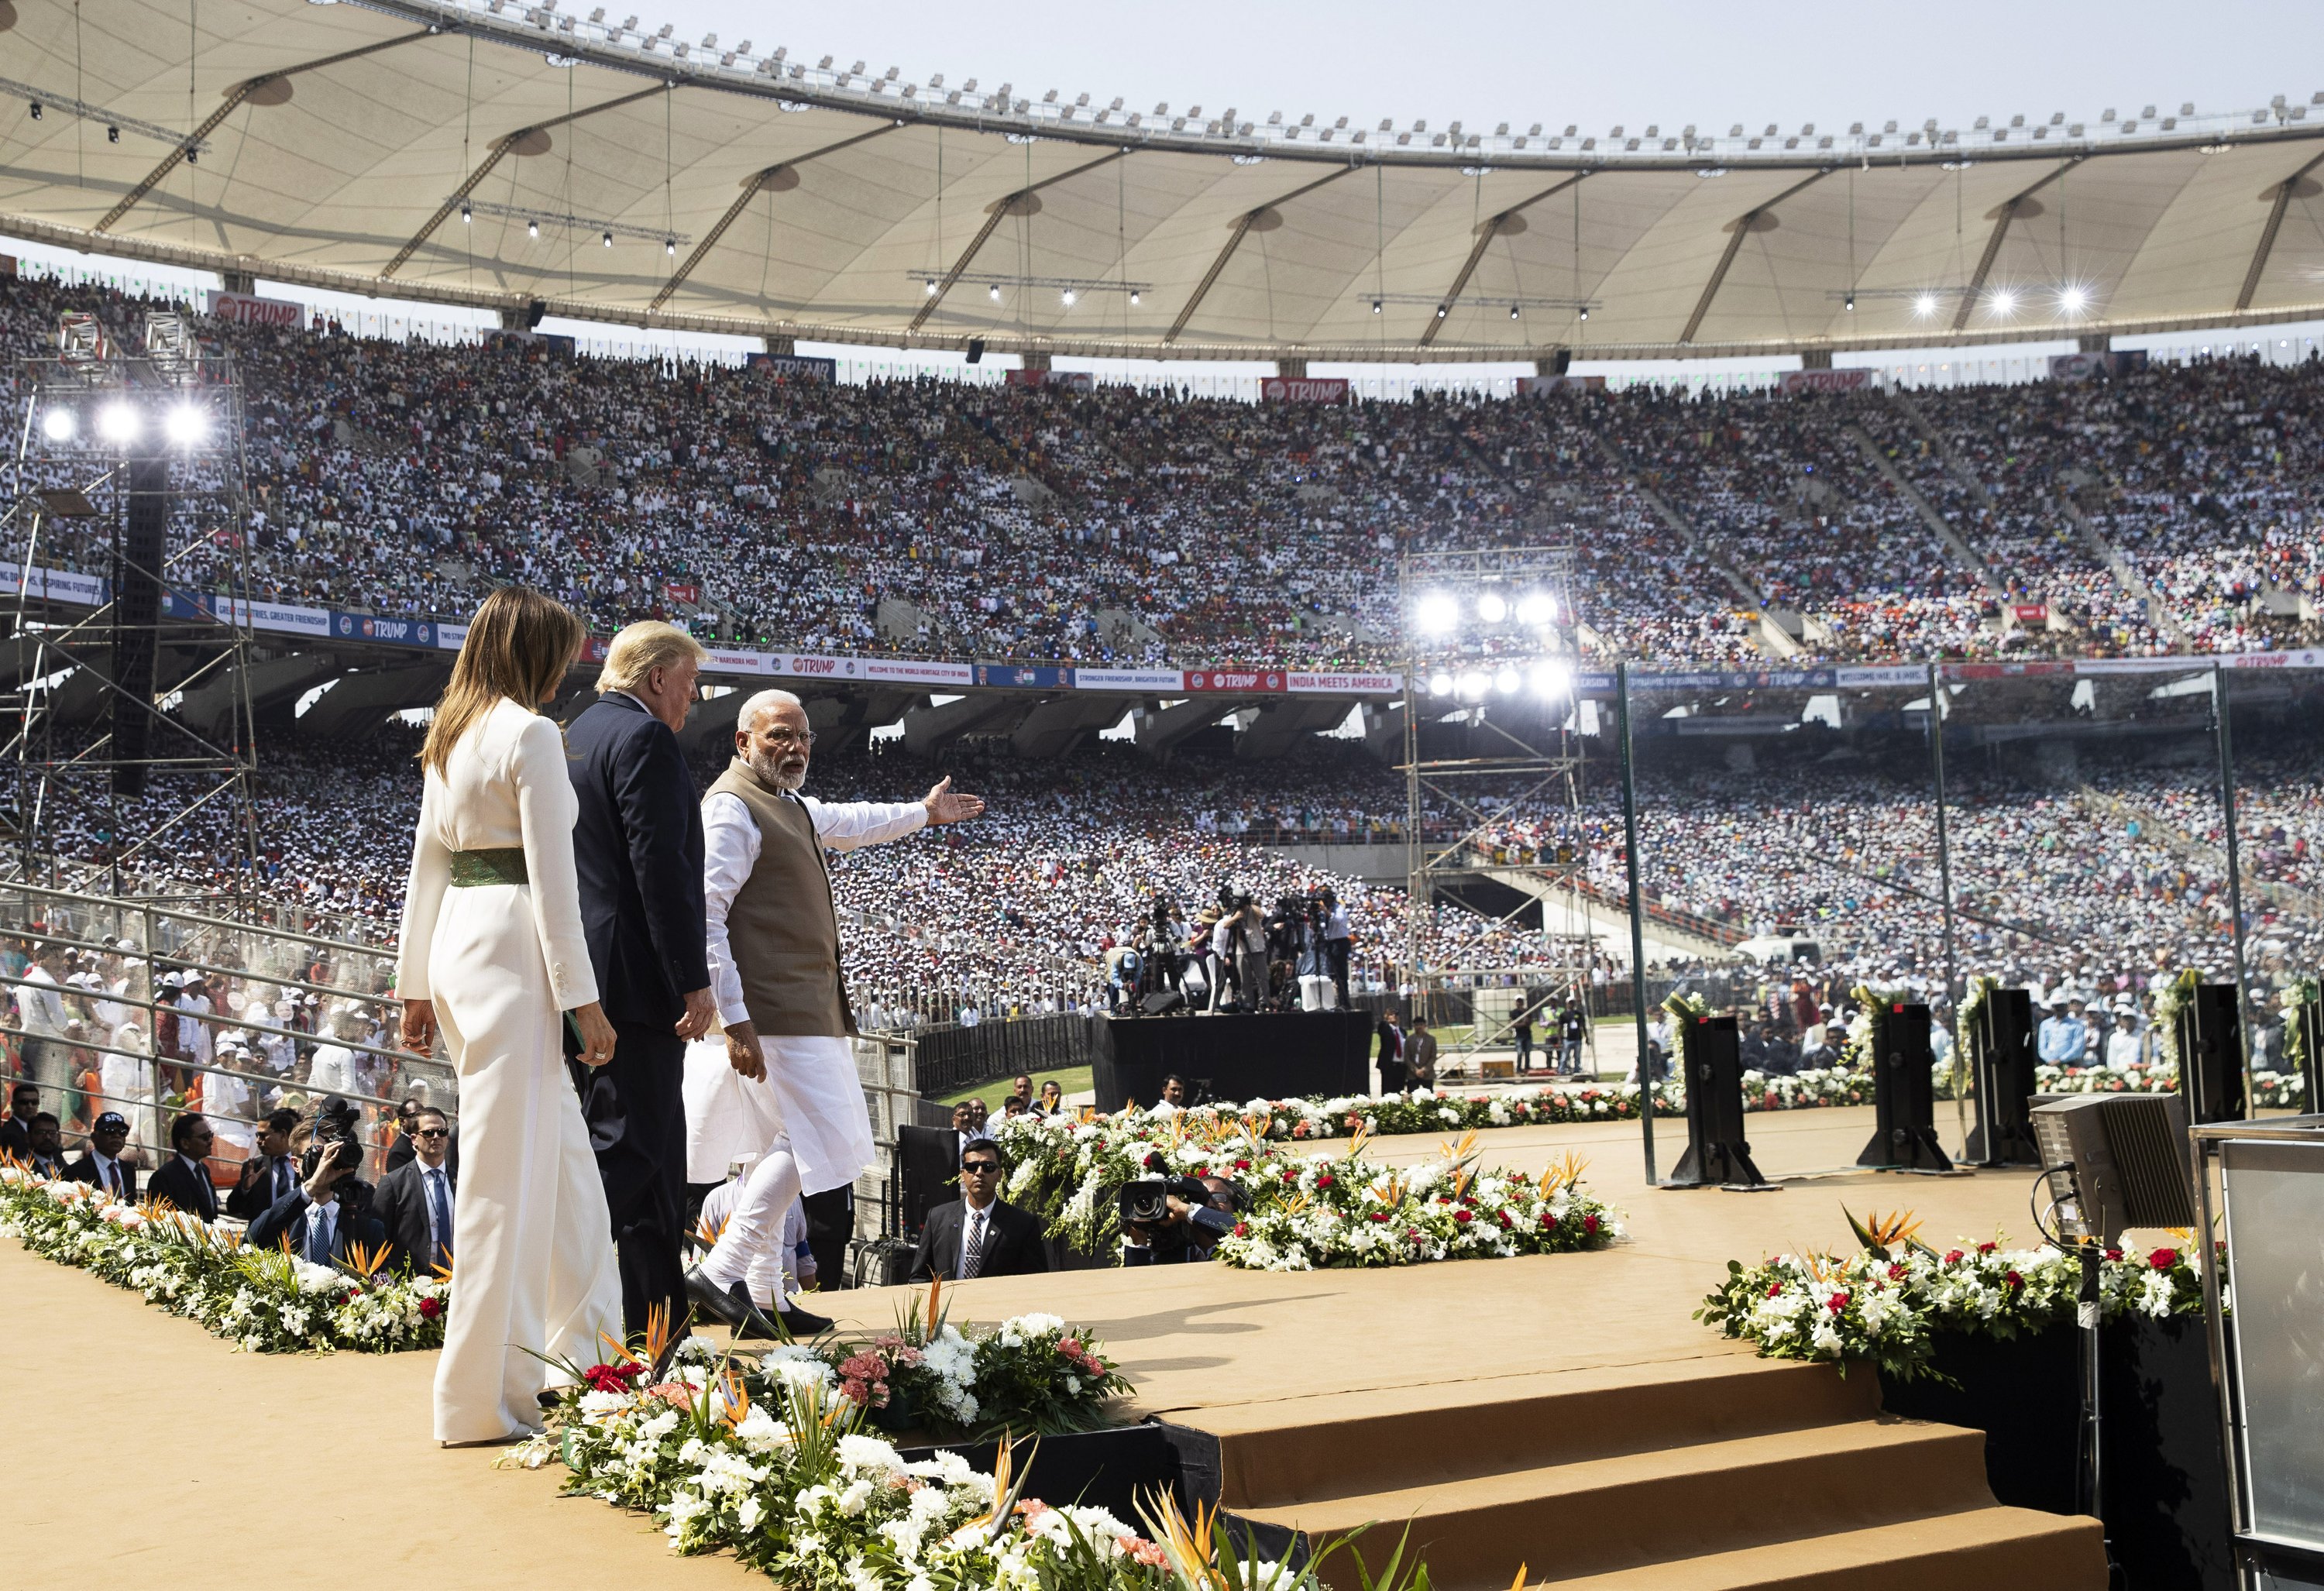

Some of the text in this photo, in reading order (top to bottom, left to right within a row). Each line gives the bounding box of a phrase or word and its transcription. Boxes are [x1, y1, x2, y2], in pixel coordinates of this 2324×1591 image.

[238, 299, 297, 325] TRUMP
[1288, 382, 1342, 401] TRUMP
[238, 607, 269, 620] COUTRIES,
[270, 611, 294, 623] GREATER
[295, 614, 327, 626] FRIENDSHIP
[373, 620, 407, 639] TRUMP
[719, 656, 744, 665] NARENDRA
[803, 658, 835, 673] TRUMP
[1226, 674, 1258, 688] TRUMP
[1289, 676, 1394, 689] INDIA MEETS AMERICA
